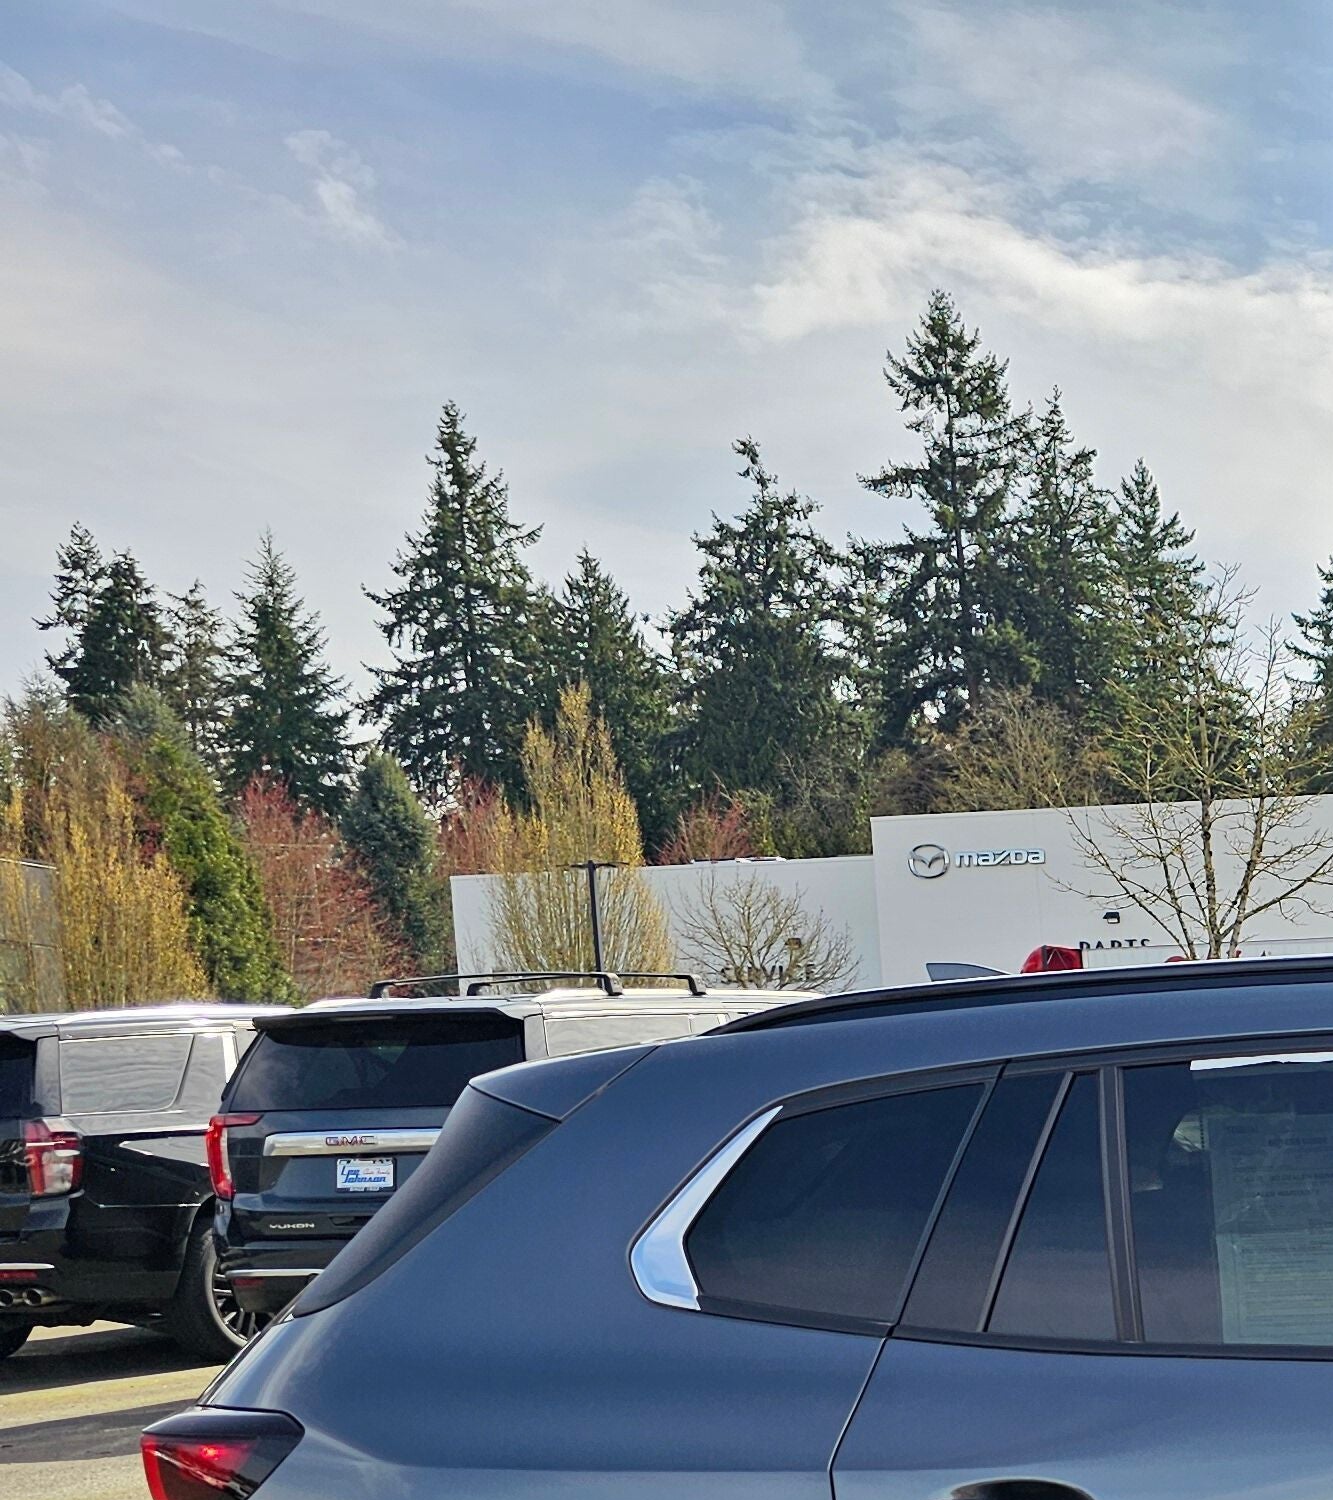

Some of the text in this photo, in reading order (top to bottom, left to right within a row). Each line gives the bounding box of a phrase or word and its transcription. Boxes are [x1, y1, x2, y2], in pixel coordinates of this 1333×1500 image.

[955, 847, 1046, 868] mazda
[325, 1135, 377, 1147] GMC
[341, 1165, 361, 1176] Lee
[269, 1222, 315, 1230] YUKON
